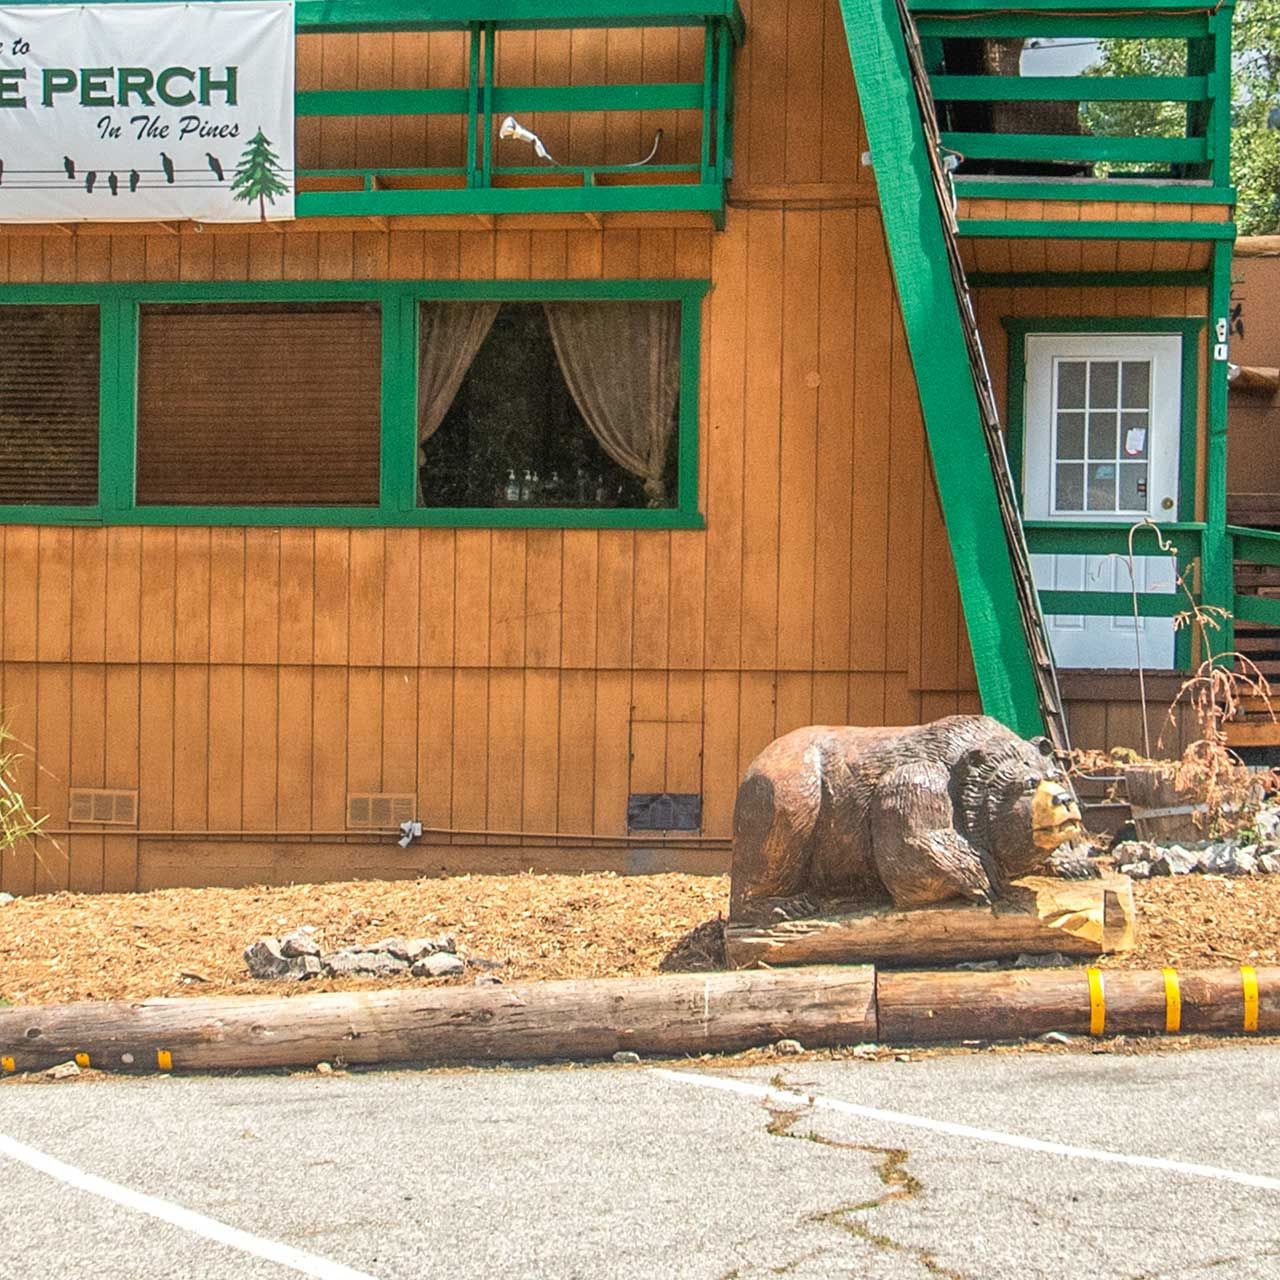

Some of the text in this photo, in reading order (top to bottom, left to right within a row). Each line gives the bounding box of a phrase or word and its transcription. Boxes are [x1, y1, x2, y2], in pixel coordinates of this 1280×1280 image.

[11, 36, 32, 56] to
[41, 65, 239, 109] PERCH
[96, 114, 241, 142] In The Pines
